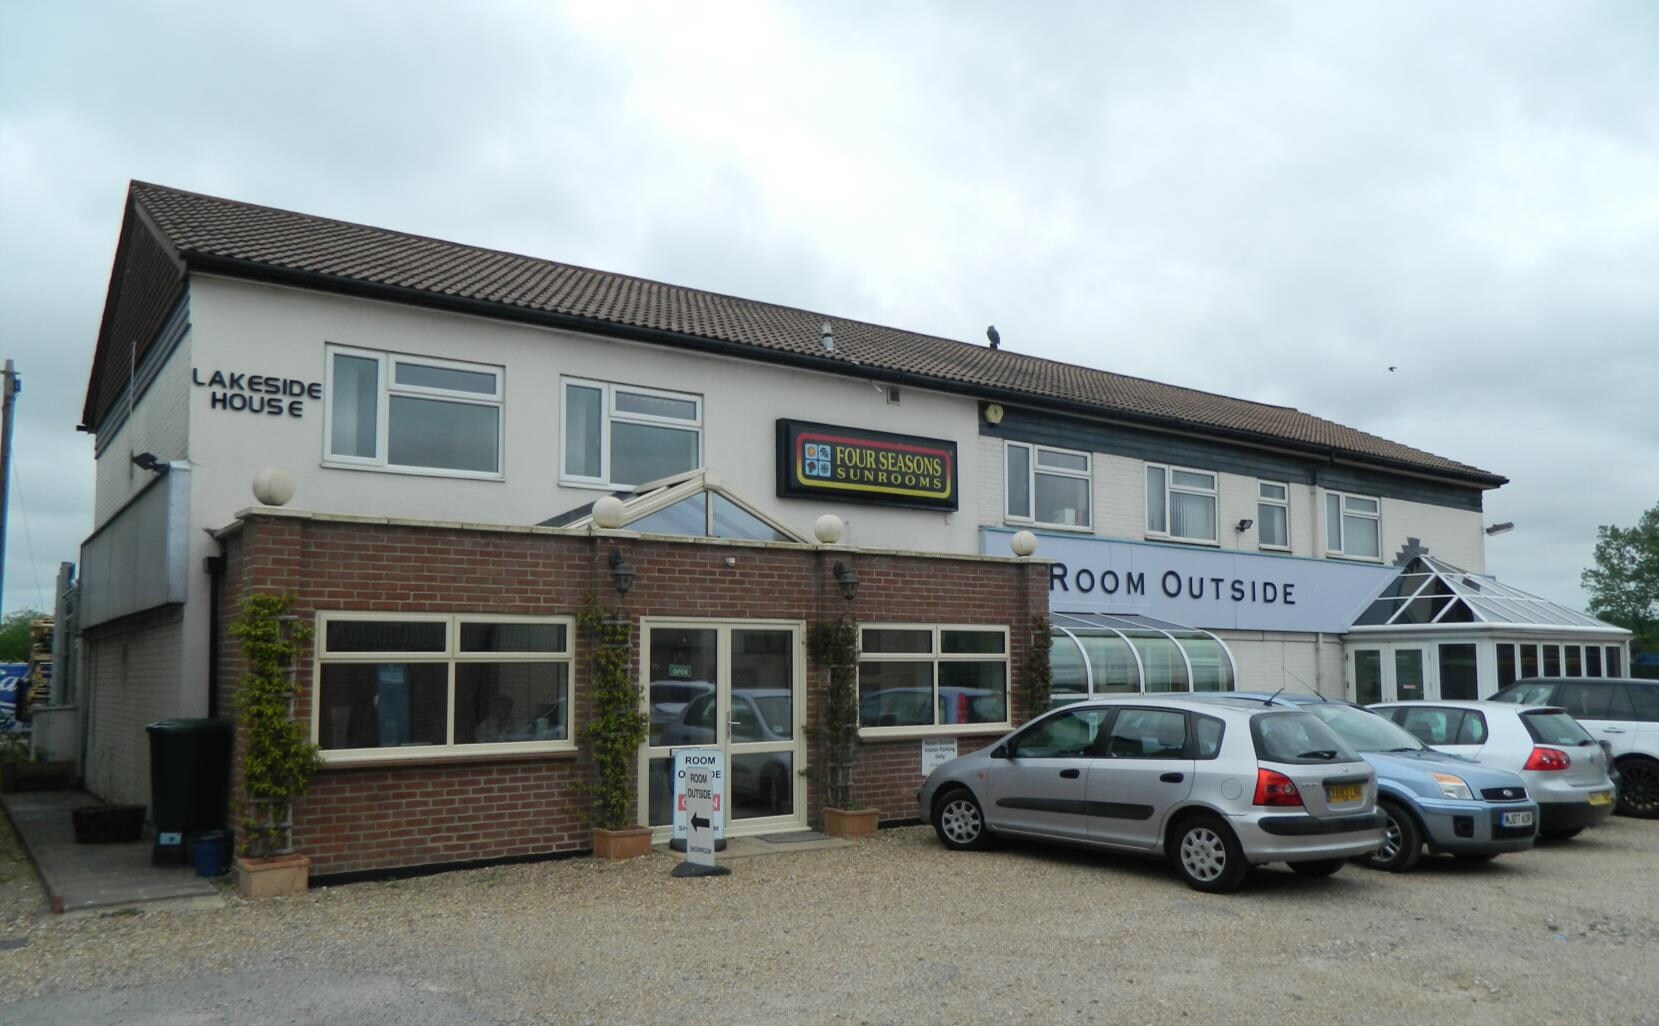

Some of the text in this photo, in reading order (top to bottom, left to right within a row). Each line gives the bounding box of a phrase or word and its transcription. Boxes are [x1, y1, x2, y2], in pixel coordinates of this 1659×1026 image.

[192, 367, 322, 400] LAKESIDE
[211, 391, 303, 418] HOUSE
[835, 446, 942, 476] FOUR SEASONS
[836, 467, 942, 489] SUNROOMS
[1049, 562, 1296, 605] ROOM OUTSIDE
[685, 756, 716, 765] ROOM
[690, 772, 708, 783] ROOM
[687, 788, 712, 799] OUTSIDE
